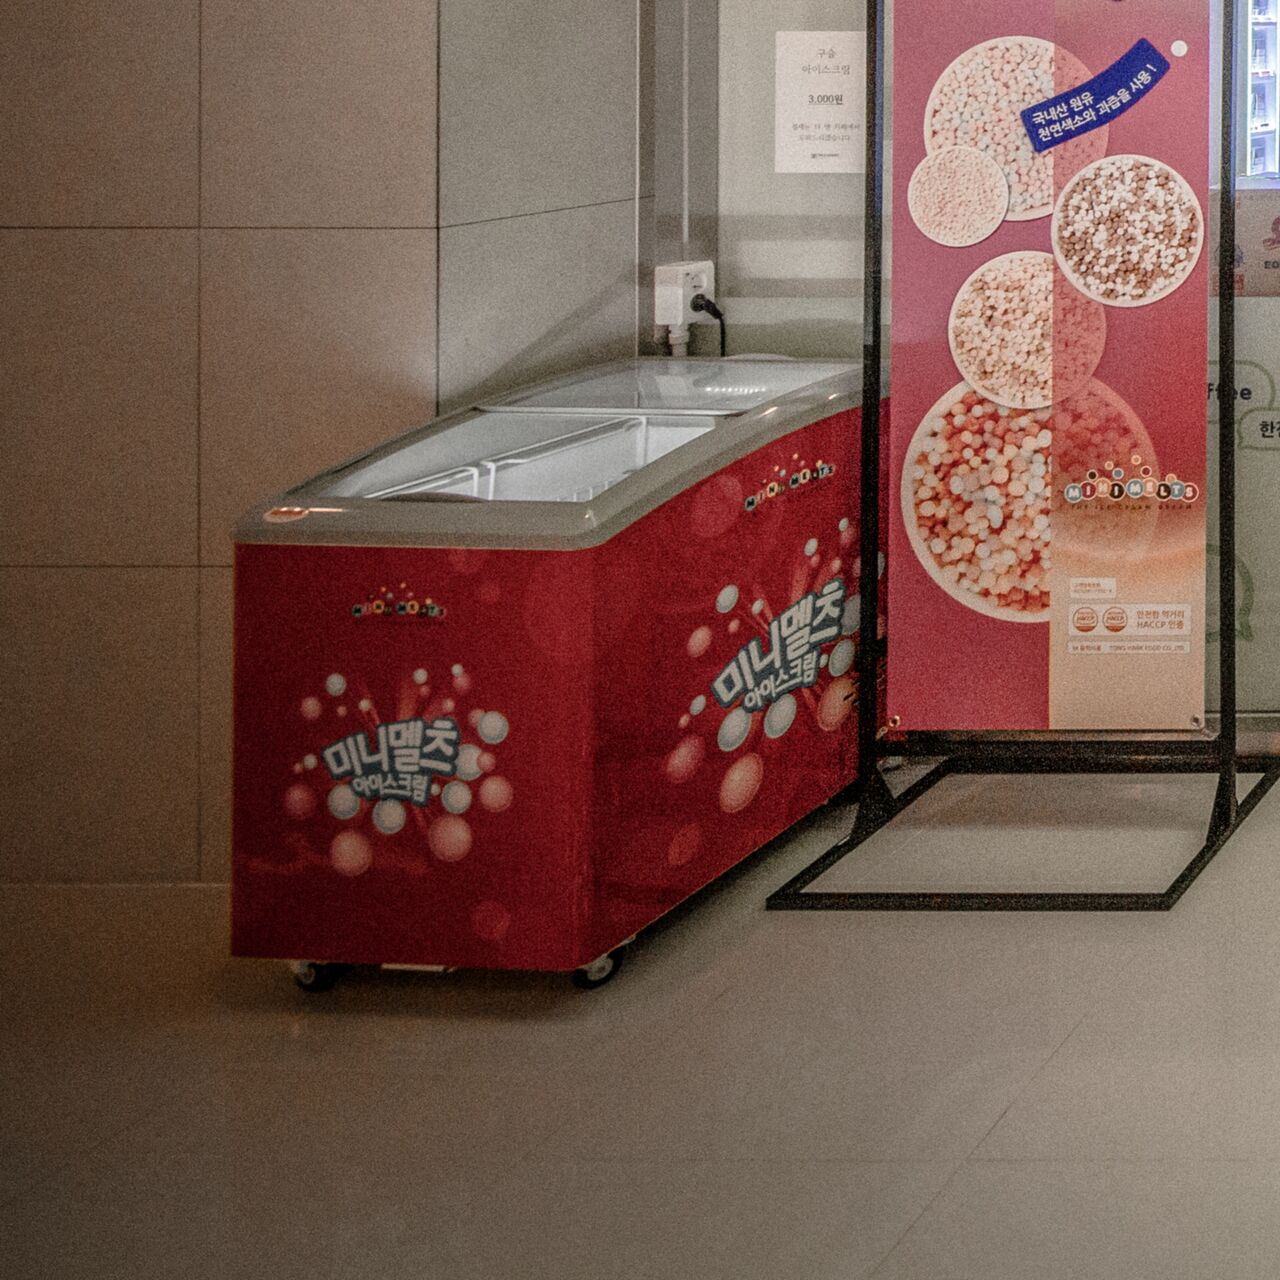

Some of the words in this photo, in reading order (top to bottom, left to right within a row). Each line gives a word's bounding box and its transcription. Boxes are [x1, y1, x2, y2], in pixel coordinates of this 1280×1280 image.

[801, 64, 851, 76] 아이스크림
[1031, 103, 1068, 125] 국내산
[1069, 91, 1095, 112] 원유
[1036, 108, 1098, 142] 천연색소와
[1095, 88, 1133, 116] 과즙을
[1066, 480, 1123, 501] MINI
[1127, 480, 1197, 501] MELTS
[712, 580, 845, 703] 미니멜츠
[1136, 621, 1167, 629] HACCP
[744, 650, 818, 708] 아이스크림
[321, 719, 459, 776] 미니멜츠
[352, 772, 428, 803] 아이스크림
